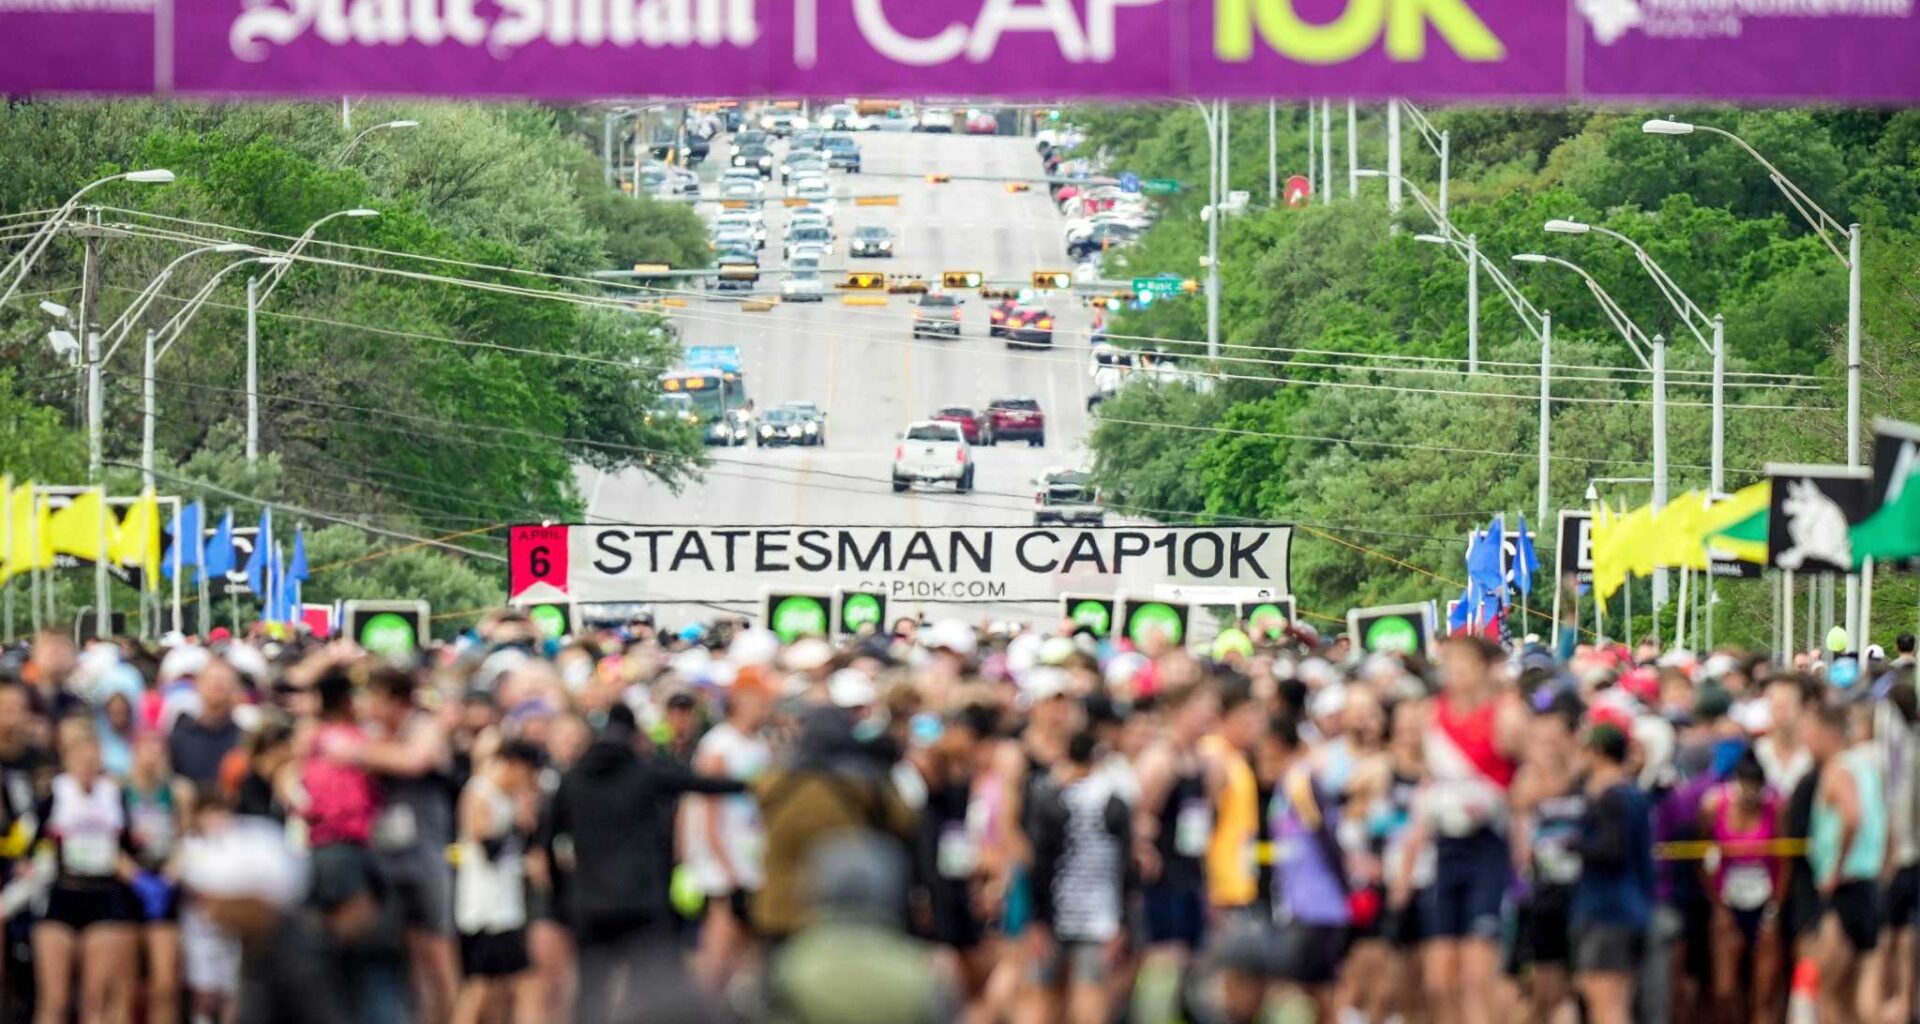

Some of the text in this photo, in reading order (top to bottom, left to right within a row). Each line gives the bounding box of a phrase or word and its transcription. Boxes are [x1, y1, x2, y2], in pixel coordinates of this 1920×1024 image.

[518, 529, 562, 541] APRIL
[530, 546, 551, 578] 6
[592, 530, 1271, 579] STATESMAN CAP10K
